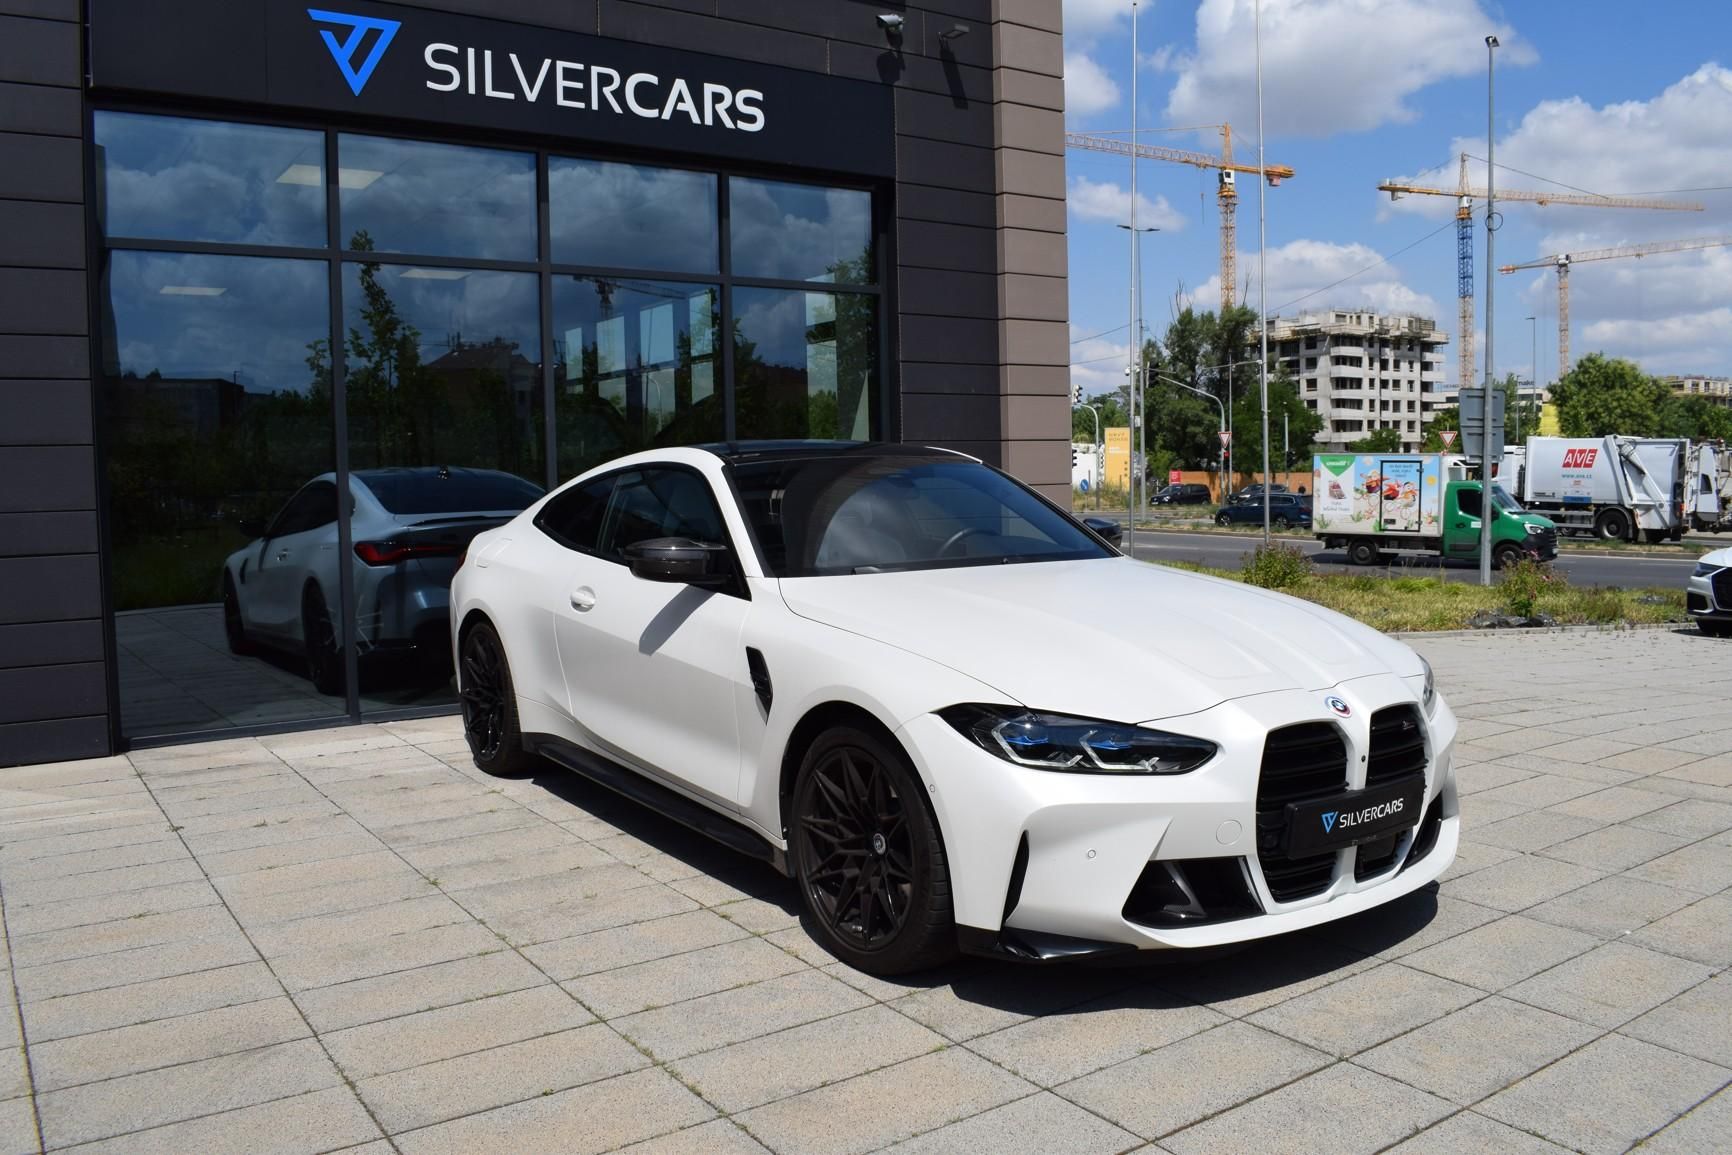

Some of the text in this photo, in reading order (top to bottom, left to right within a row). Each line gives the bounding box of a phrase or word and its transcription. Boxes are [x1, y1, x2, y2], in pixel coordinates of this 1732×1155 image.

[424, 42, 765, 132] SILVERCARS
[1564, 452, 1595, 465] AVE
[1339, 798, 1404, 828] SILVERCARS
